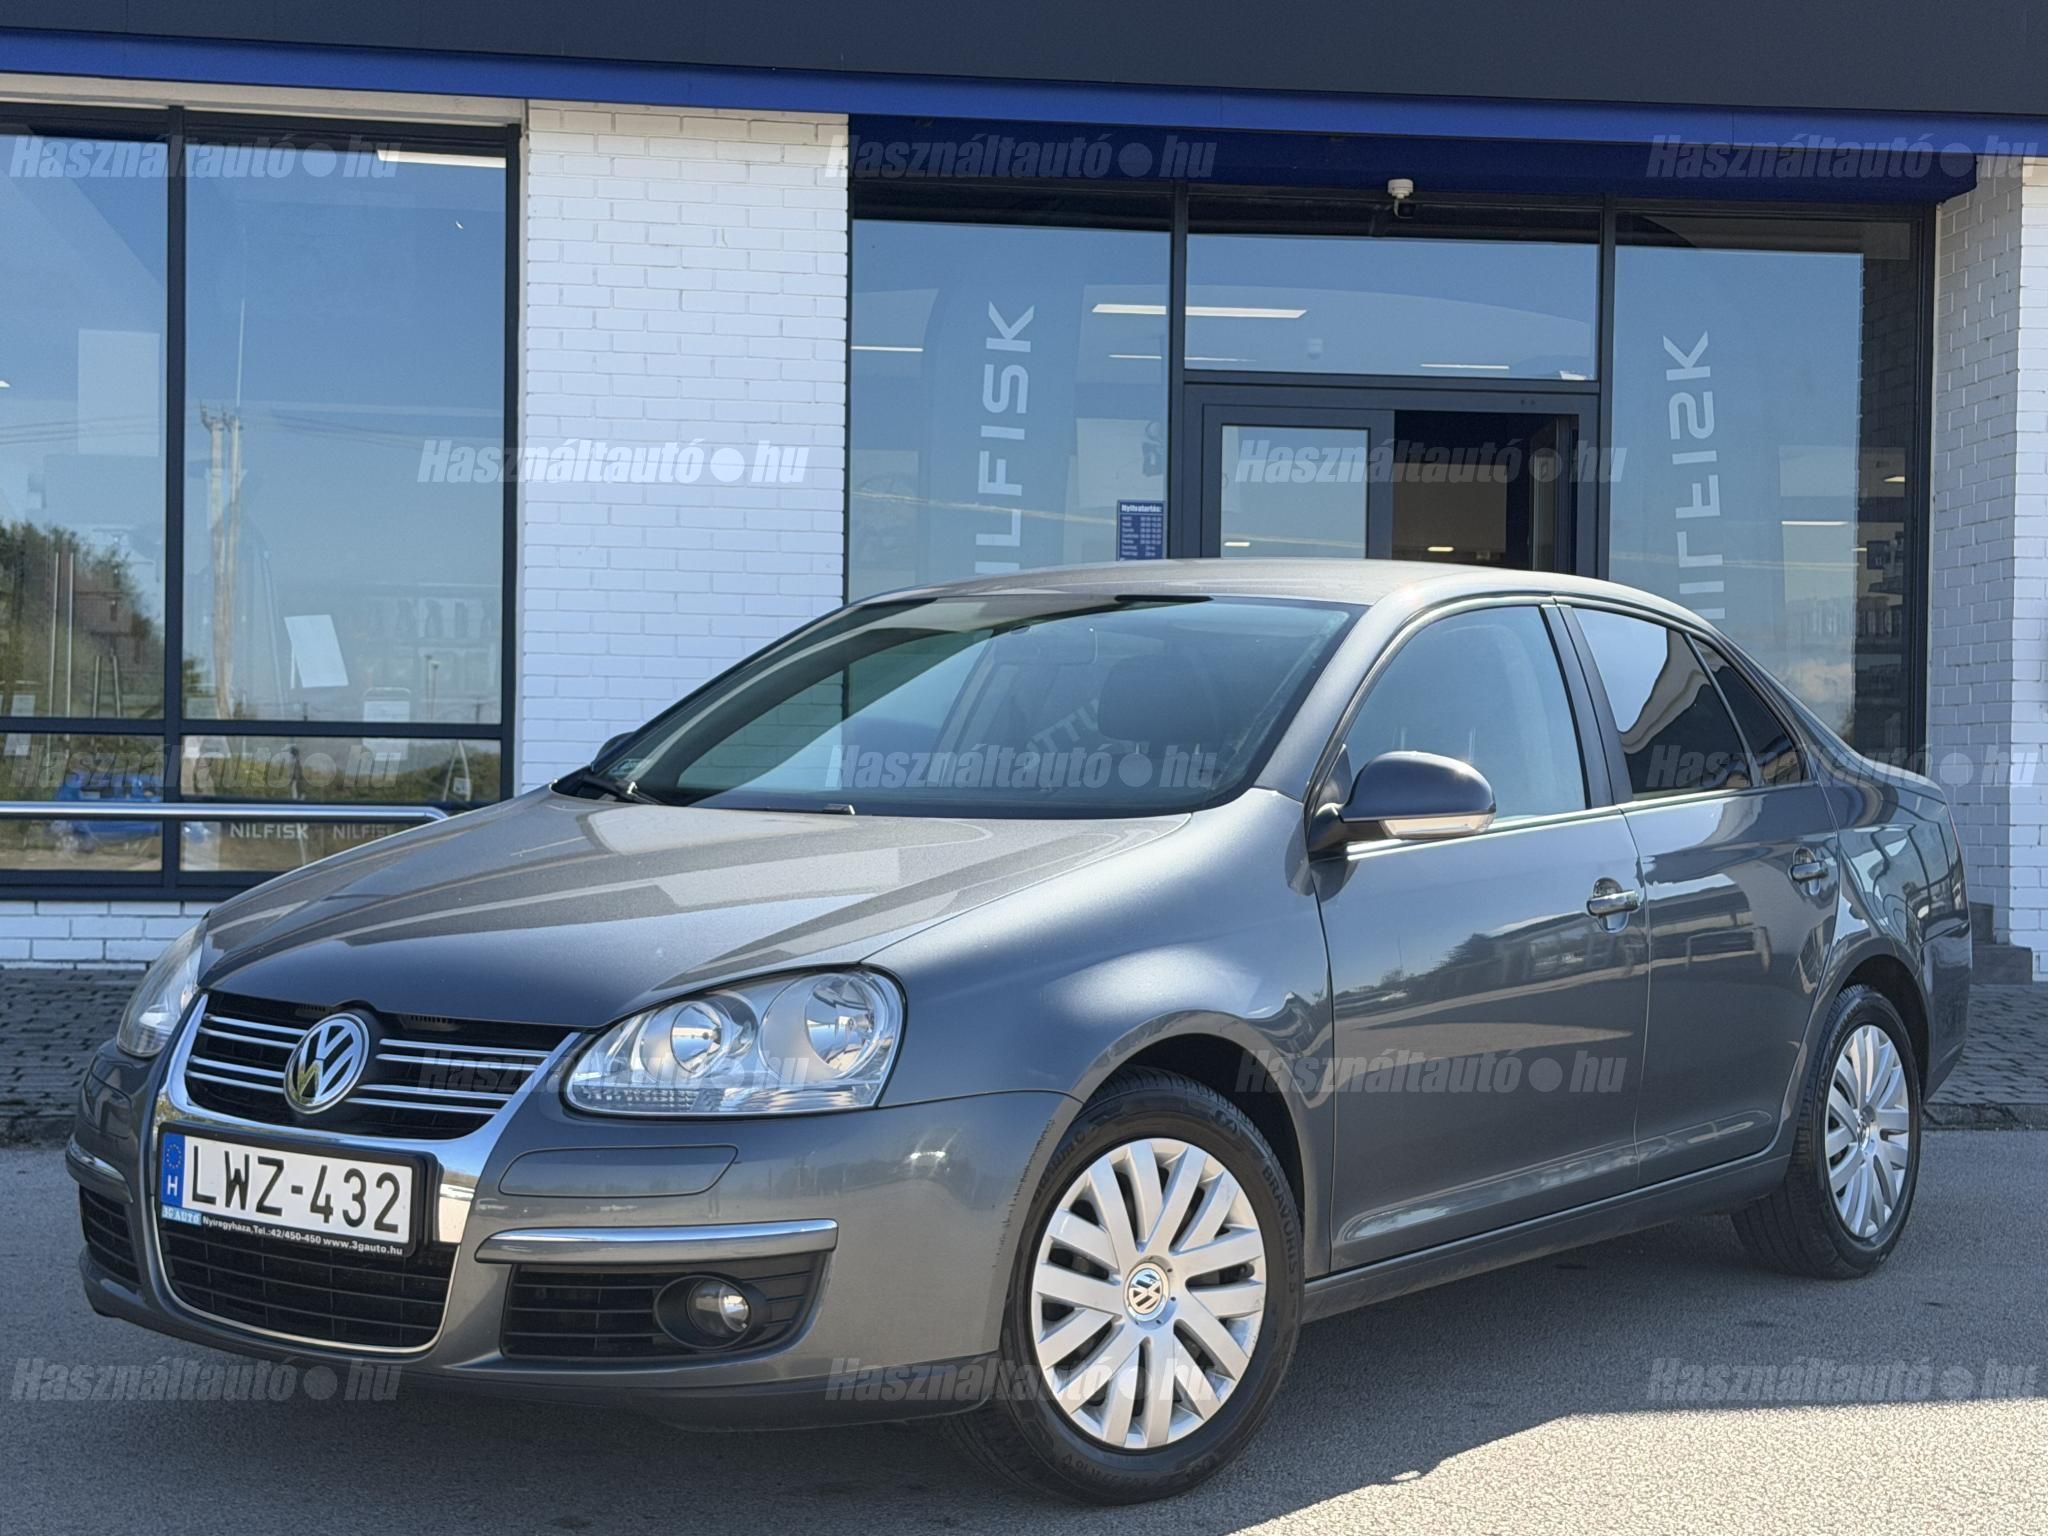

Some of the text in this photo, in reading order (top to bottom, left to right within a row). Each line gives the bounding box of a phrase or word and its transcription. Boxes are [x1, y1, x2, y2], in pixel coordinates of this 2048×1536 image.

[230, 823, 310, 840] NILFISK
[166, 1175, 179, 1198] H
[191, 1145, 401, 1234] LWZ-432
[323, 1238, 403, 1256] www.3gauto.hu
